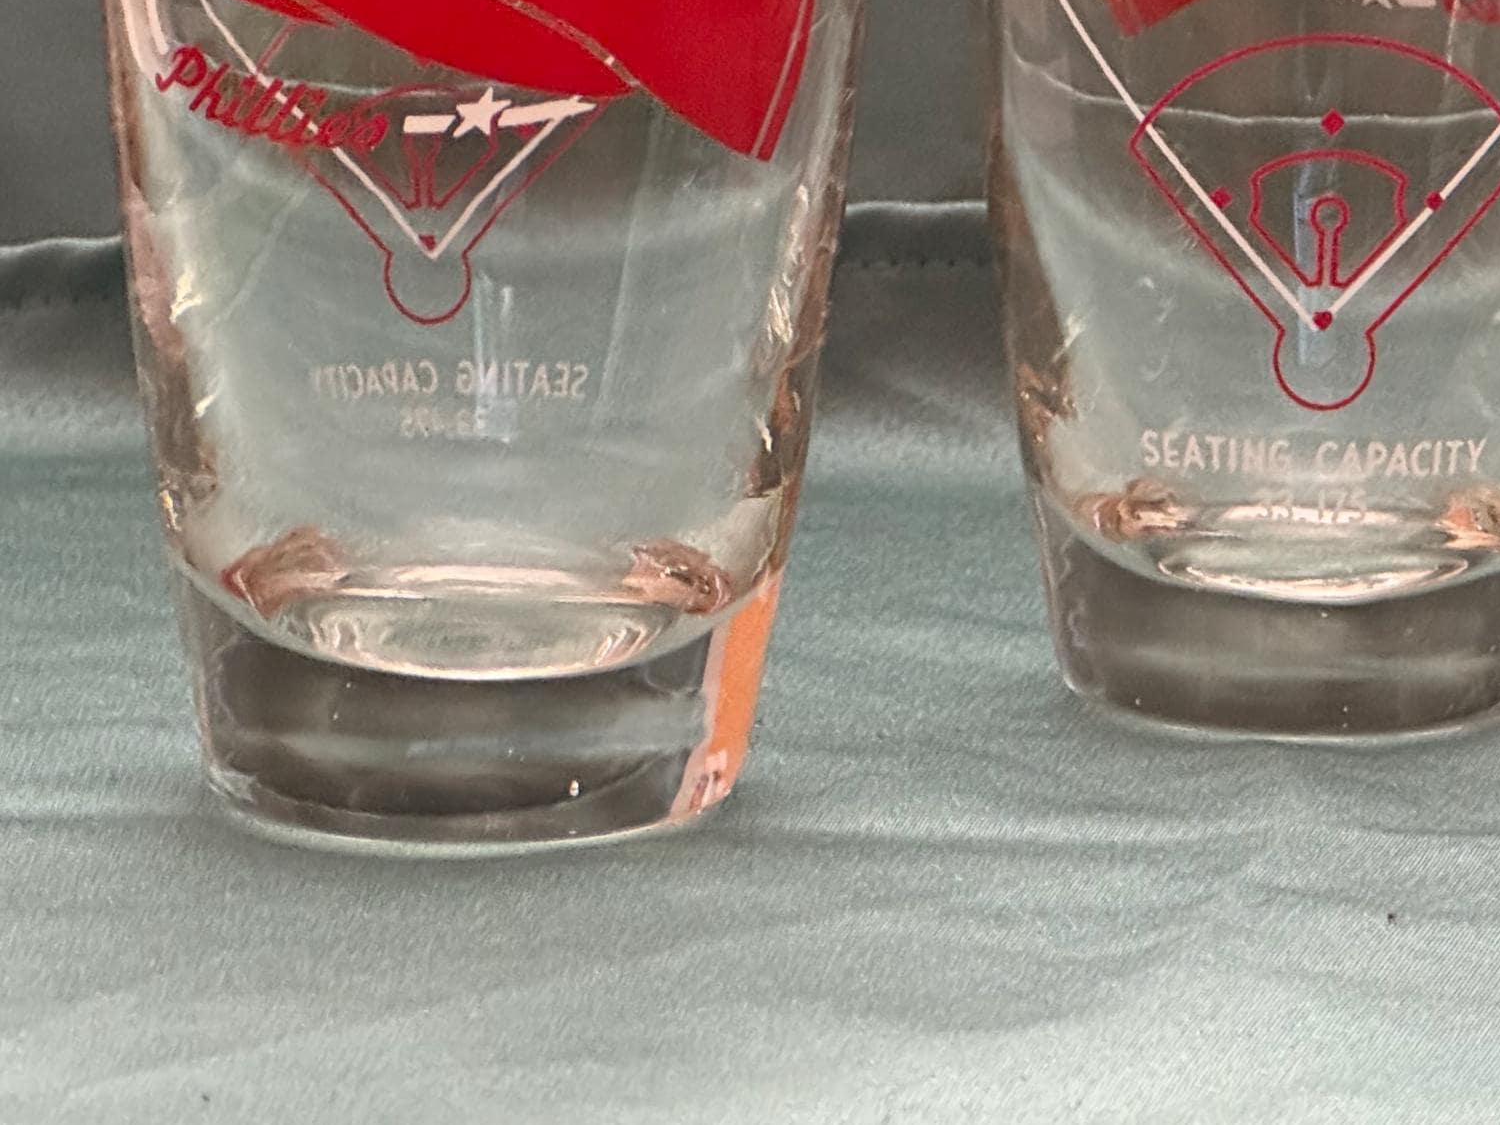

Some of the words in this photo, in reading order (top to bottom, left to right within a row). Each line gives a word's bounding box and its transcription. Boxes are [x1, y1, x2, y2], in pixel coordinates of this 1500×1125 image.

[155, 44, 390, 150] Phillies
[1140, 428, 1291, 475] SEATING
[1313, 436, 1488, 478] CAPACITY
